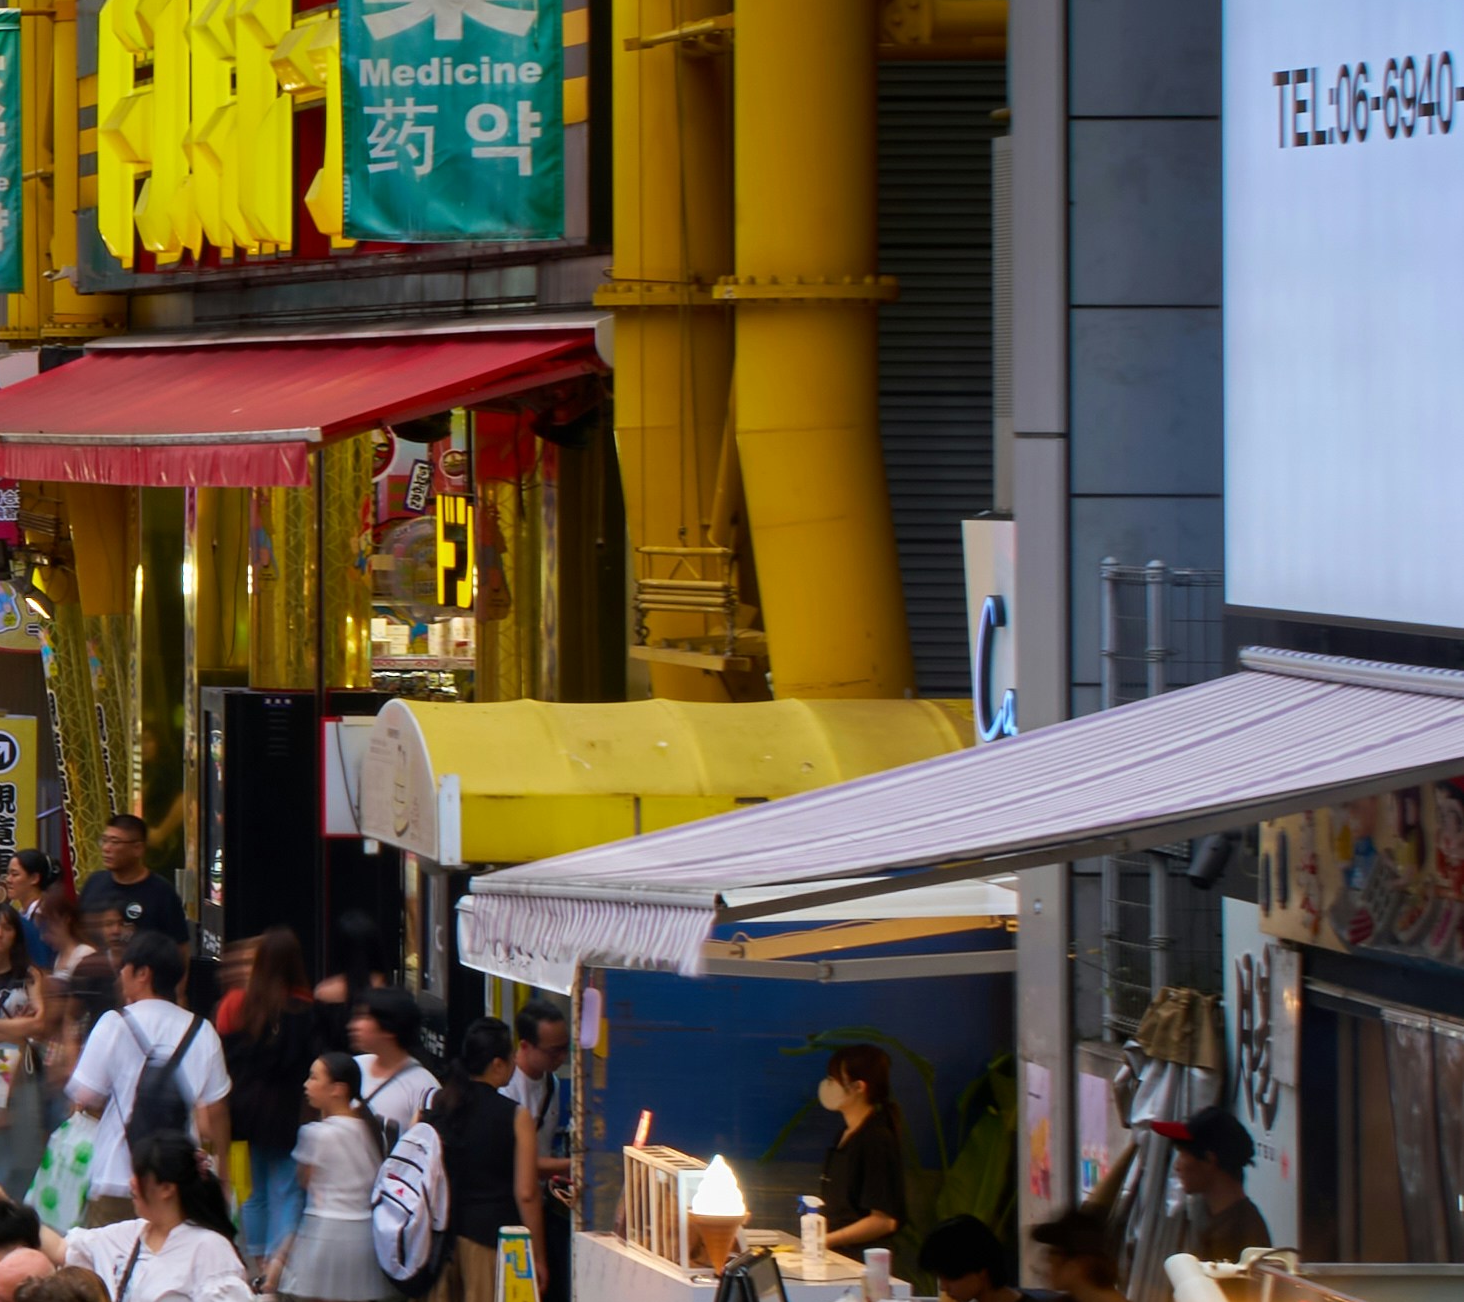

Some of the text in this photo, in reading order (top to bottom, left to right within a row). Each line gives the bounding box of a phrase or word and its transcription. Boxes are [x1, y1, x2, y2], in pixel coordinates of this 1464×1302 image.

[359, 55, 543, 88] Medicine
[364, 103, 438, 177] 药
[465, 99, 542, 177] 약
